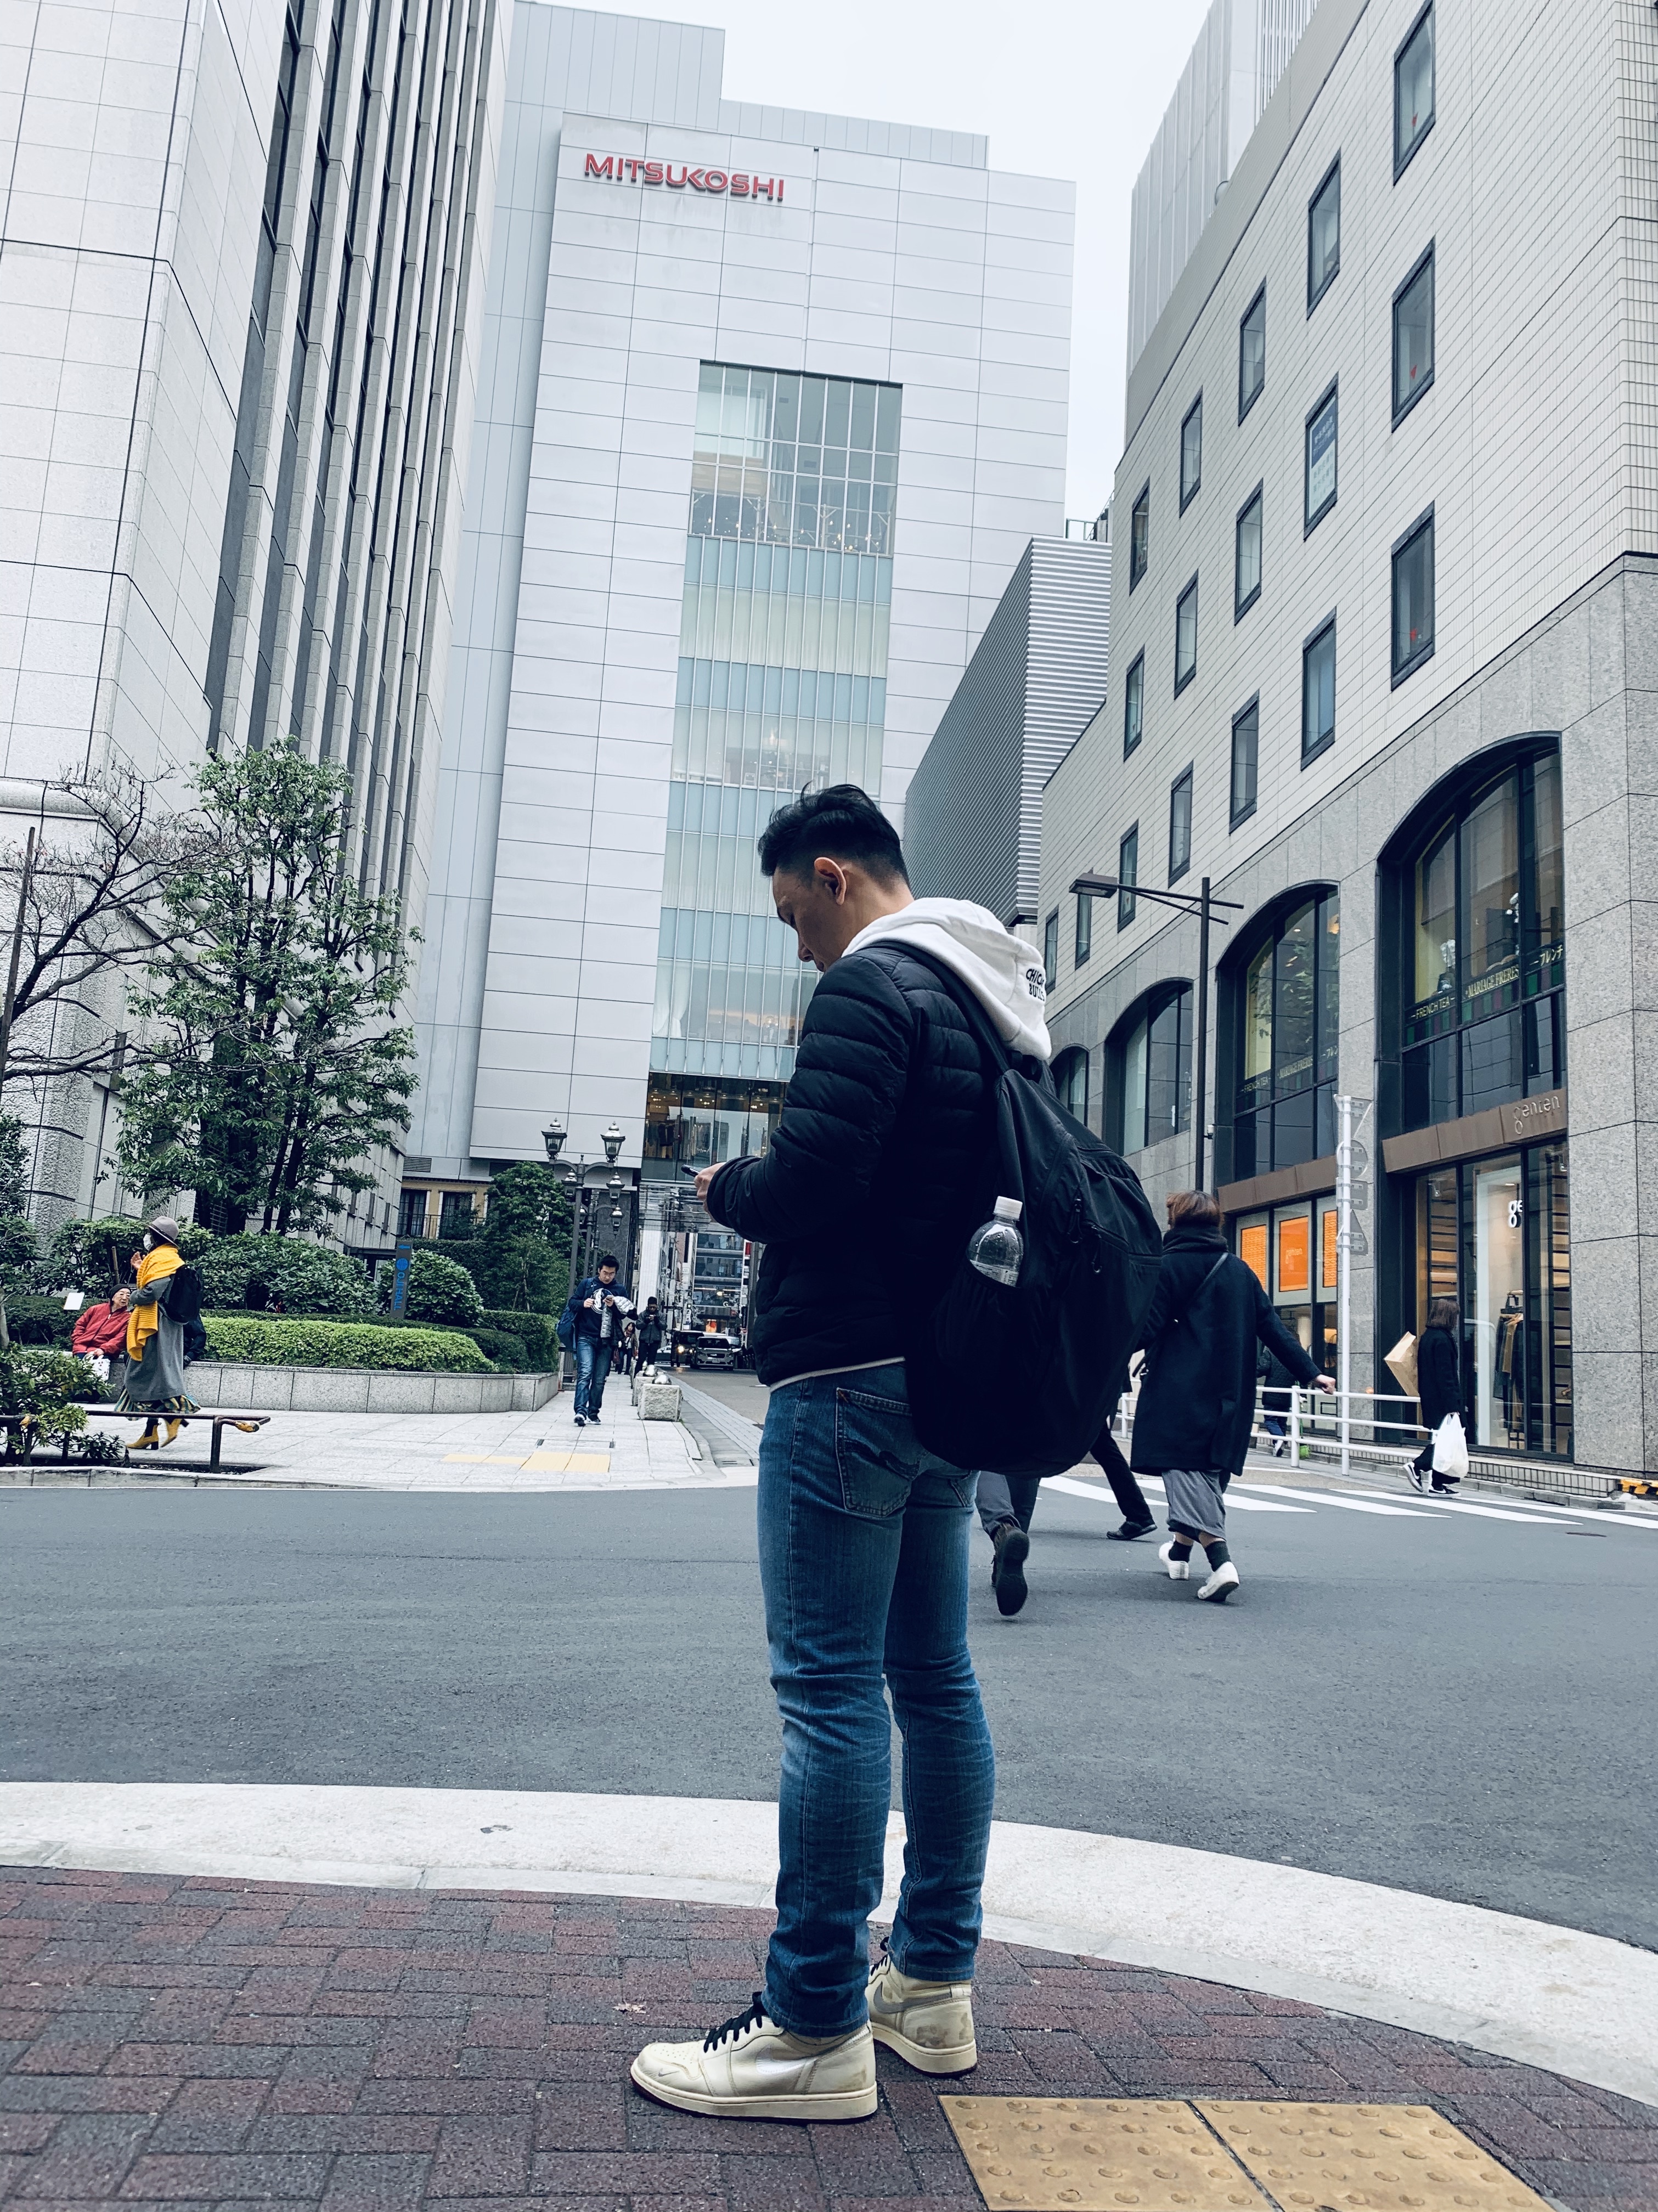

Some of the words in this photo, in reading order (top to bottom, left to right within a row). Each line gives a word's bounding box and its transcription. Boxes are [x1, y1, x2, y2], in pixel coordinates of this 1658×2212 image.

[584, 153, 785, 201] MITSUKOSHI
[1539, 944, 1564, 967] フレンチ
[1029, 984, 1045, 1002] BULLS
[1468, 974, 1496, 998] MARIAGE
[1415, 1001, 1439, 1019] FRENCH
[1439, 996, 1450, 1009] TEA
[1513, 1096, 1561, 1135] genten
[396, 1272, 405, 1286] OJI
[394, 1288, 403, 1311] HALL
